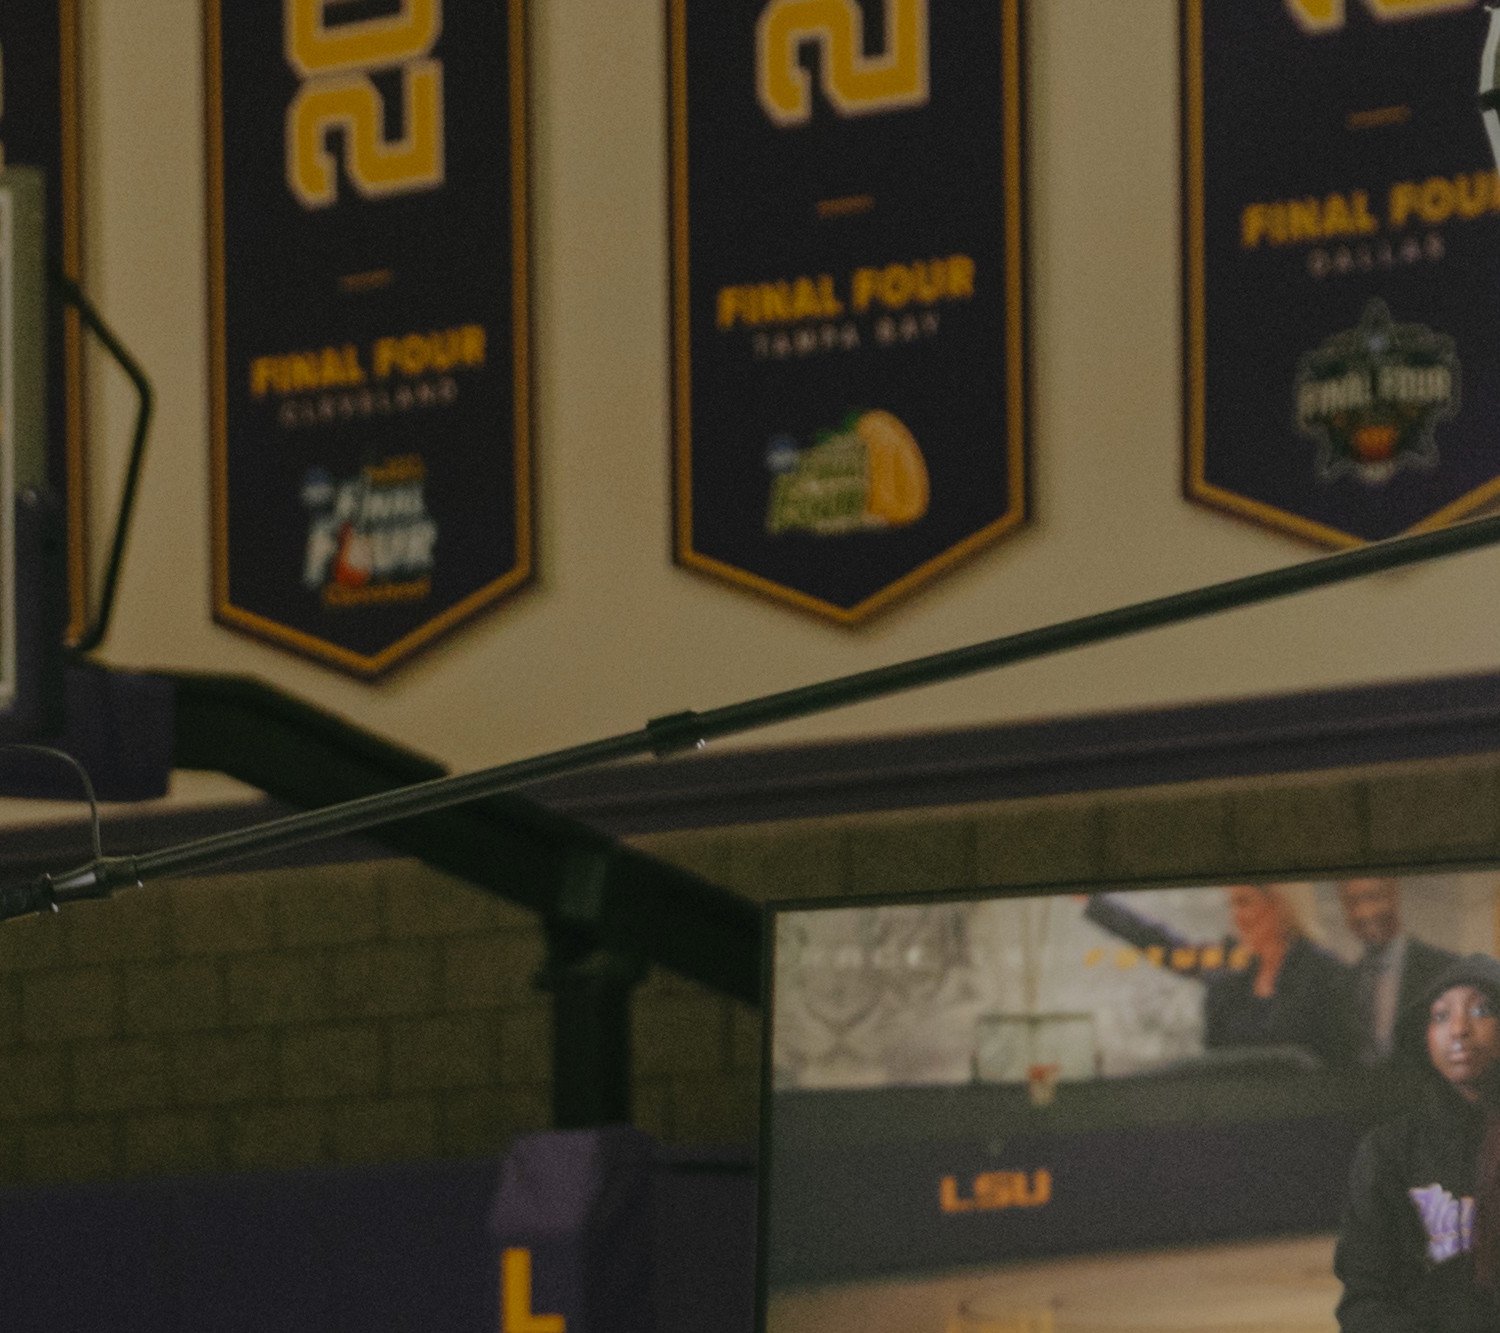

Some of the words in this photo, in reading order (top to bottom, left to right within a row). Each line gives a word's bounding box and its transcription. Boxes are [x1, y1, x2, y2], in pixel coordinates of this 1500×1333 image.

[1241, 190, 1379, 247] FINAL
[717, 273, 844, 331] FINAL
[853, 254, 975, 312] FOUR
[252, 345, 366, 400] FINAL
[373, 323, 486, 378] FOUR
[753, 322, 860, 358] TAMPA
[876, 312, 940, 345] BAY
[941, 1168, 1052, 1213] LSU
